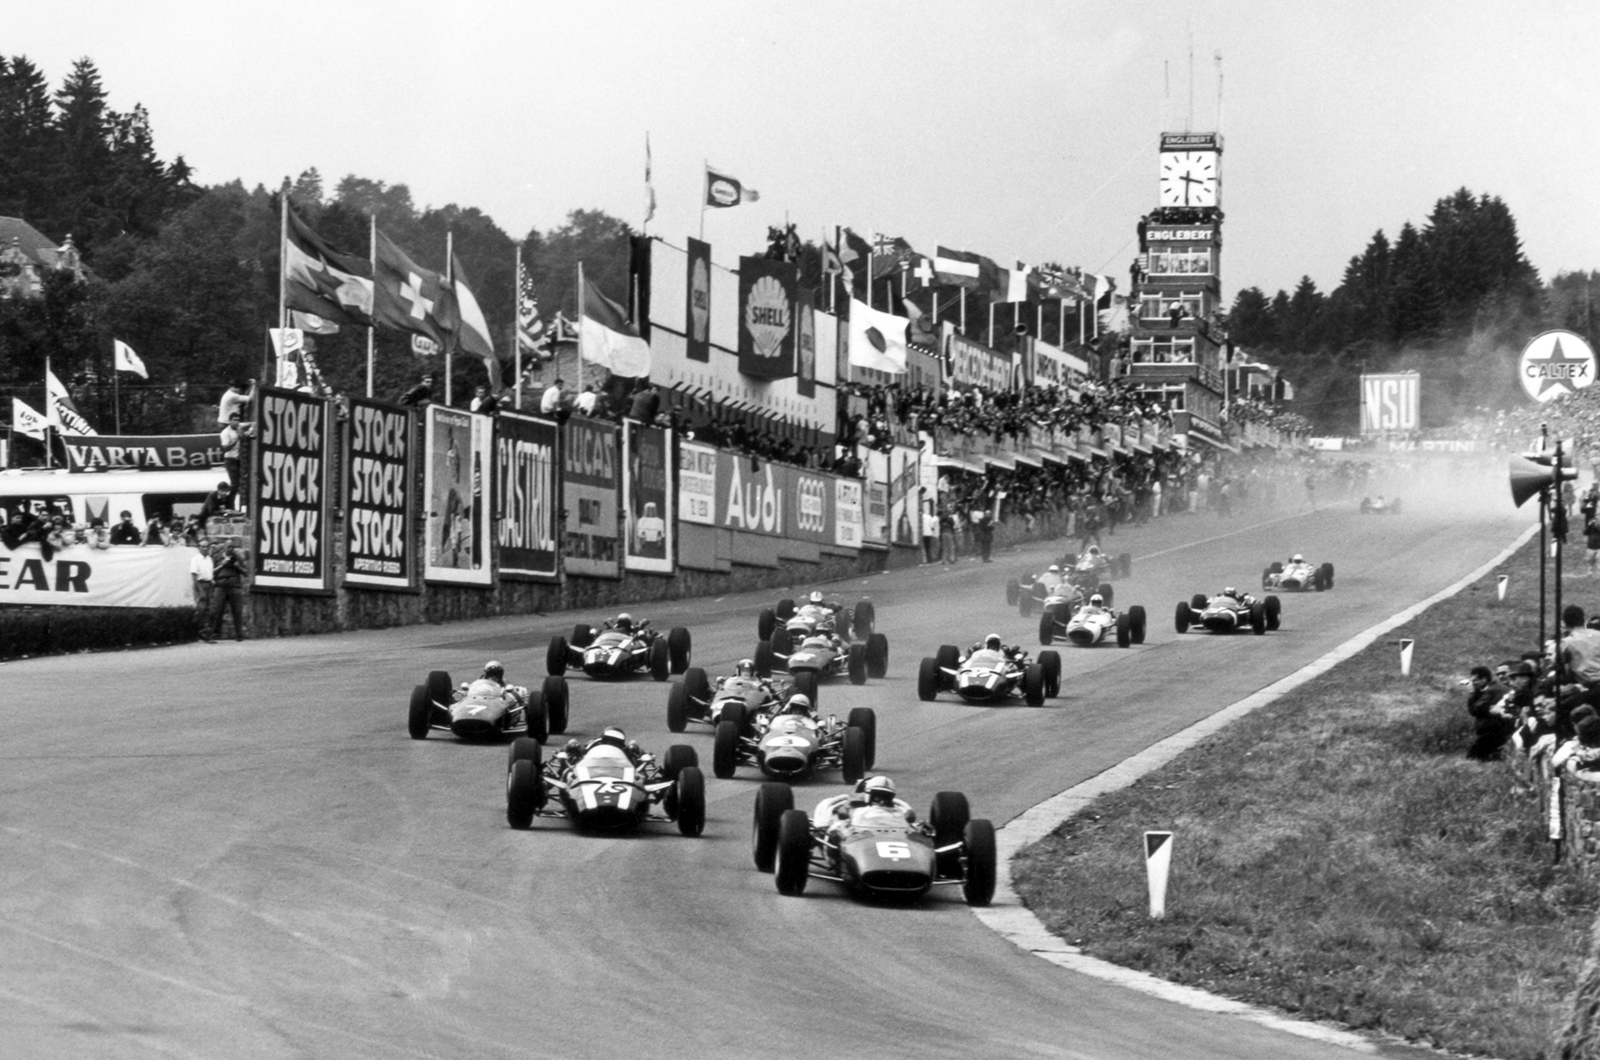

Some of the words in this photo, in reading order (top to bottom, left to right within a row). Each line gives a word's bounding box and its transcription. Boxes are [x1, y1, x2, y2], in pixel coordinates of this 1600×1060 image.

[1165, 136, 1213, 145] ENGLEBERT
[1146, 230, 1213, 241] ENGLEBERT
[752, 306, 785, 328] SHELL
[1525, 363, 1589, 379] CALTEX
[262, 395, 321, 451] STOCK
[1363, 379, 1416, 430] NSU
[66, 444, 165, 467] VARTA
[352, 405, 406, 459] STOCK
[564, 423, 614, 479] LUCAS
[261, 450, 320, 504] STOCK
[351, 456, 404, 508] STOCK
[497, 437, 555, 552] CASTROL
[259, 505, 318, 557] STOCK
[350, 507, 403, 558] STOCK
[465, 704, 487, 716] 7
[782, 738, 794, 746] 3
[875, 841, 911, 859] 6
